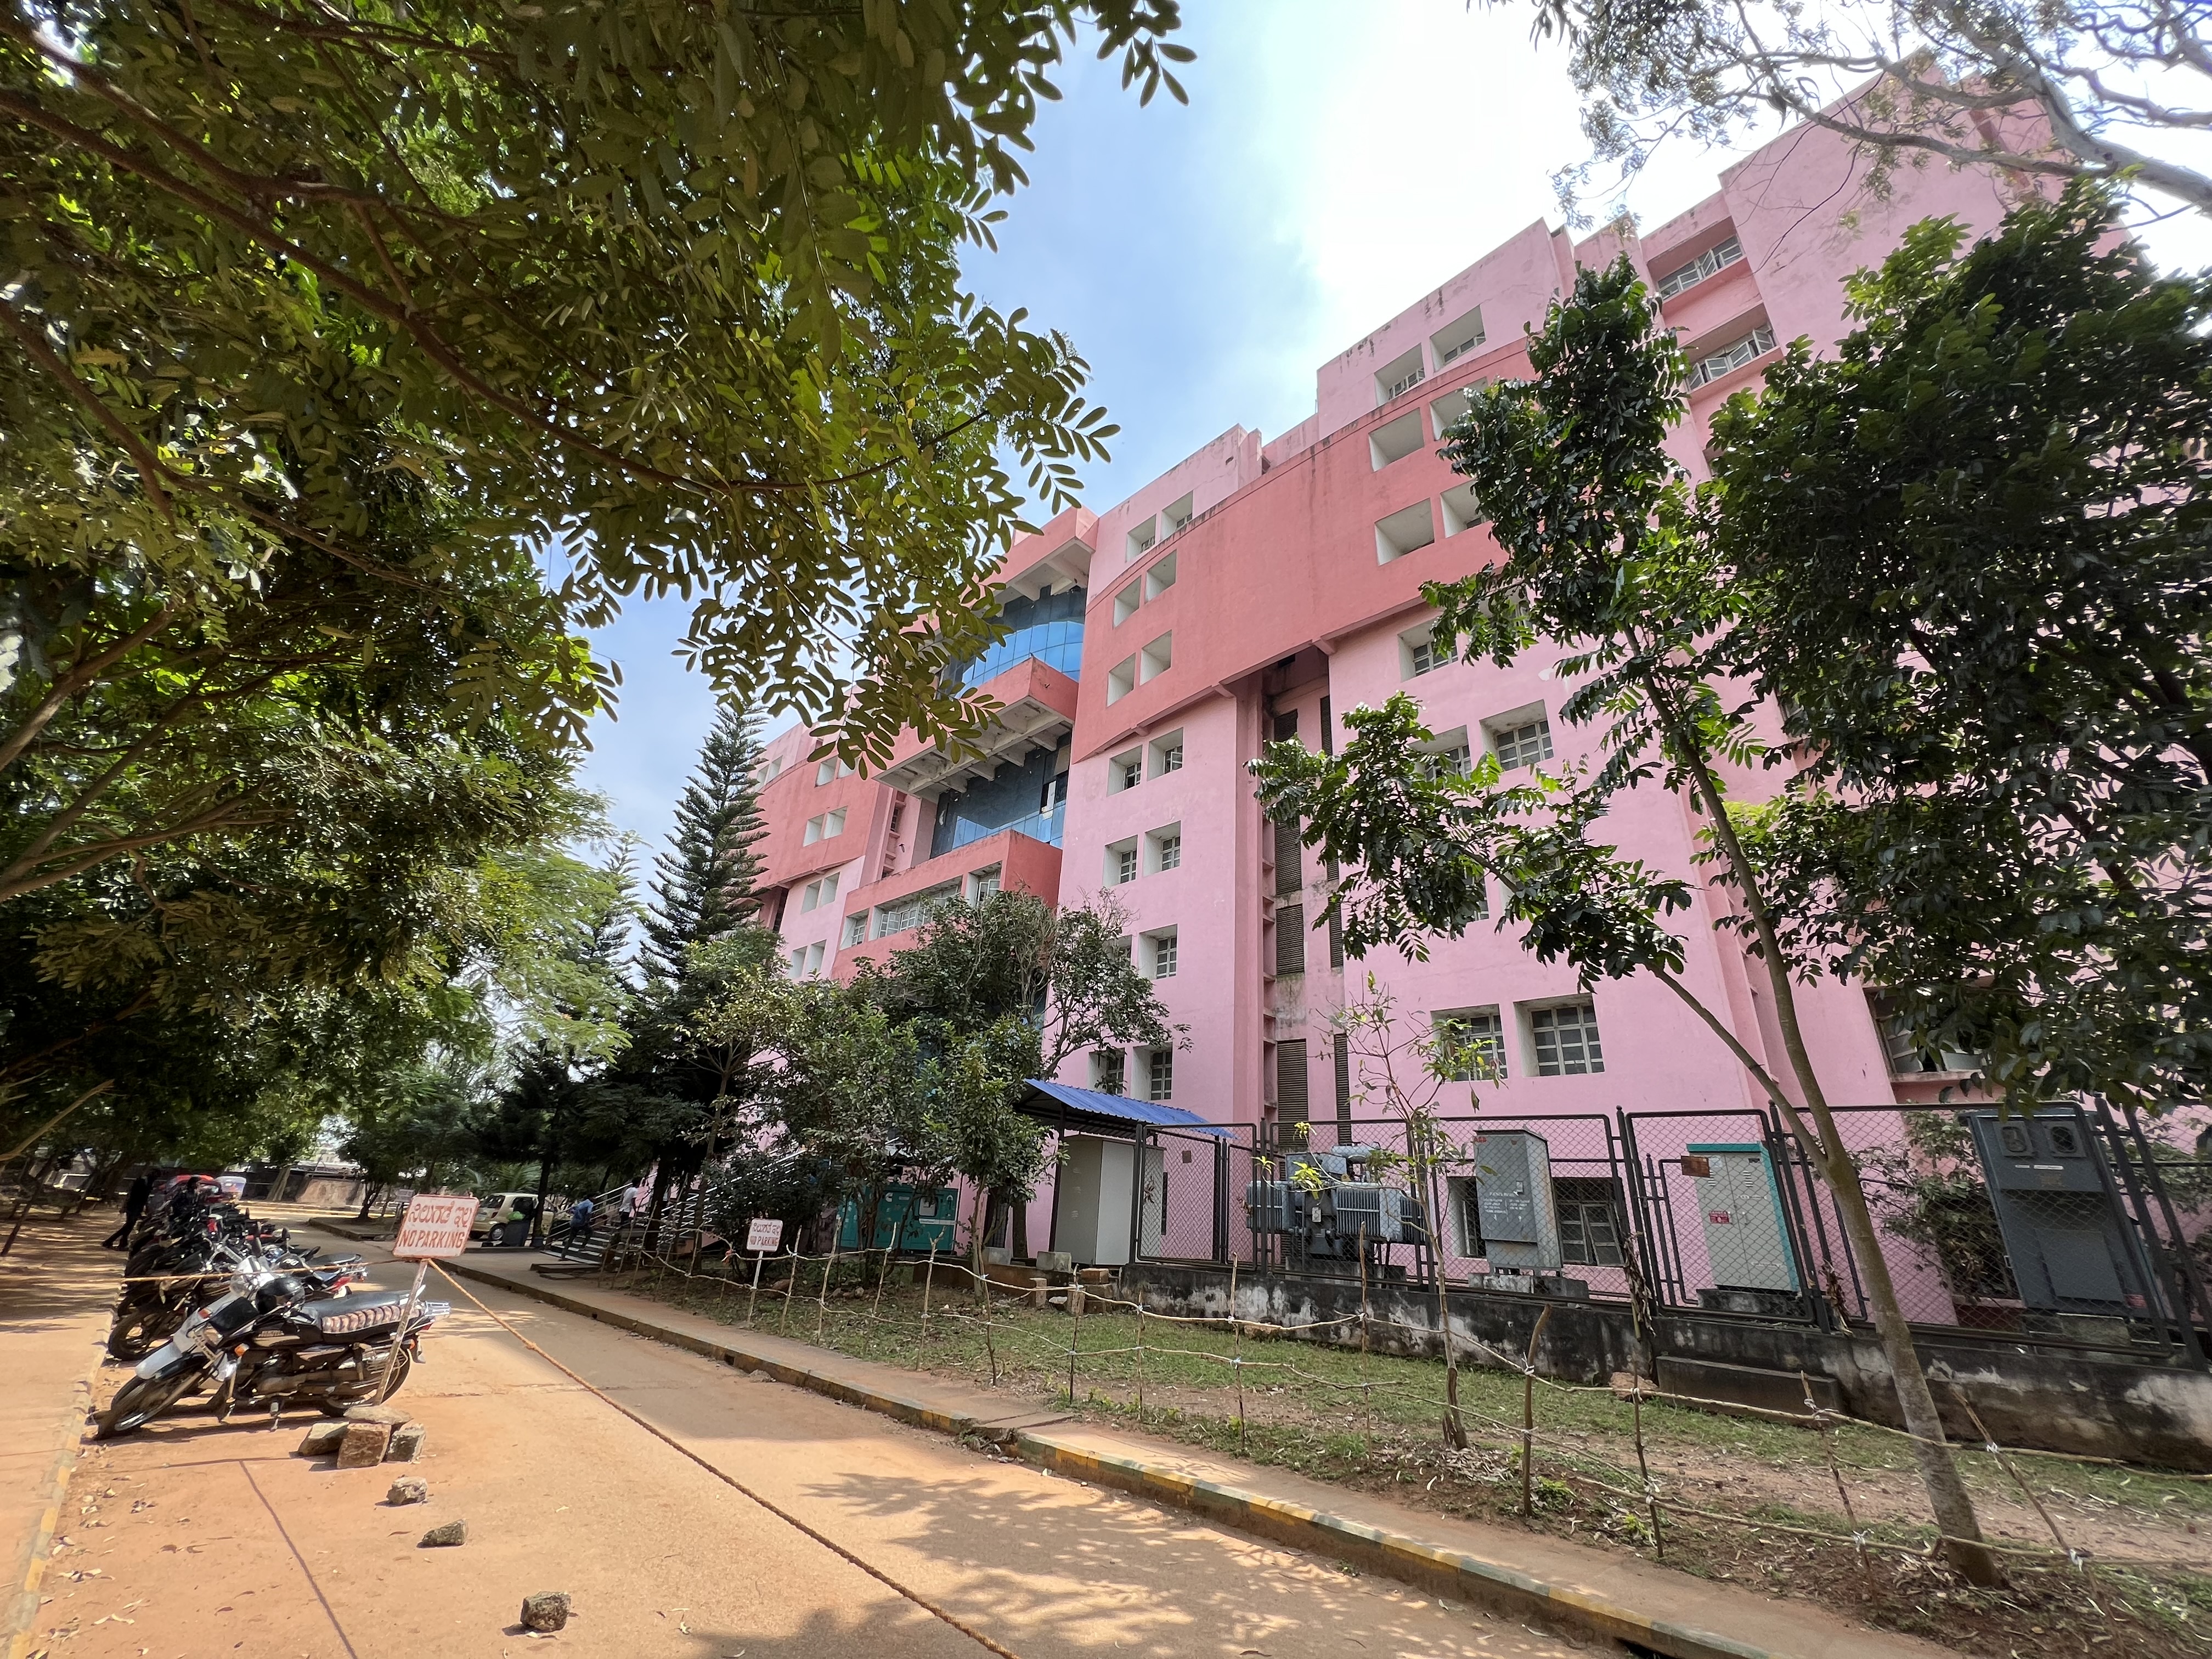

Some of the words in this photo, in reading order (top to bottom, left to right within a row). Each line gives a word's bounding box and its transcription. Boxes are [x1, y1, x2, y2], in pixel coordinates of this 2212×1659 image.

[408, 1200, 455, 1224] ನಿಲುಗಡೆ
[454, 1206, 472, 1228] ಇಲ್ಲ
[398, 1229, 417, 1248] NO
[415, 1229, 465, 1249] PARKING
